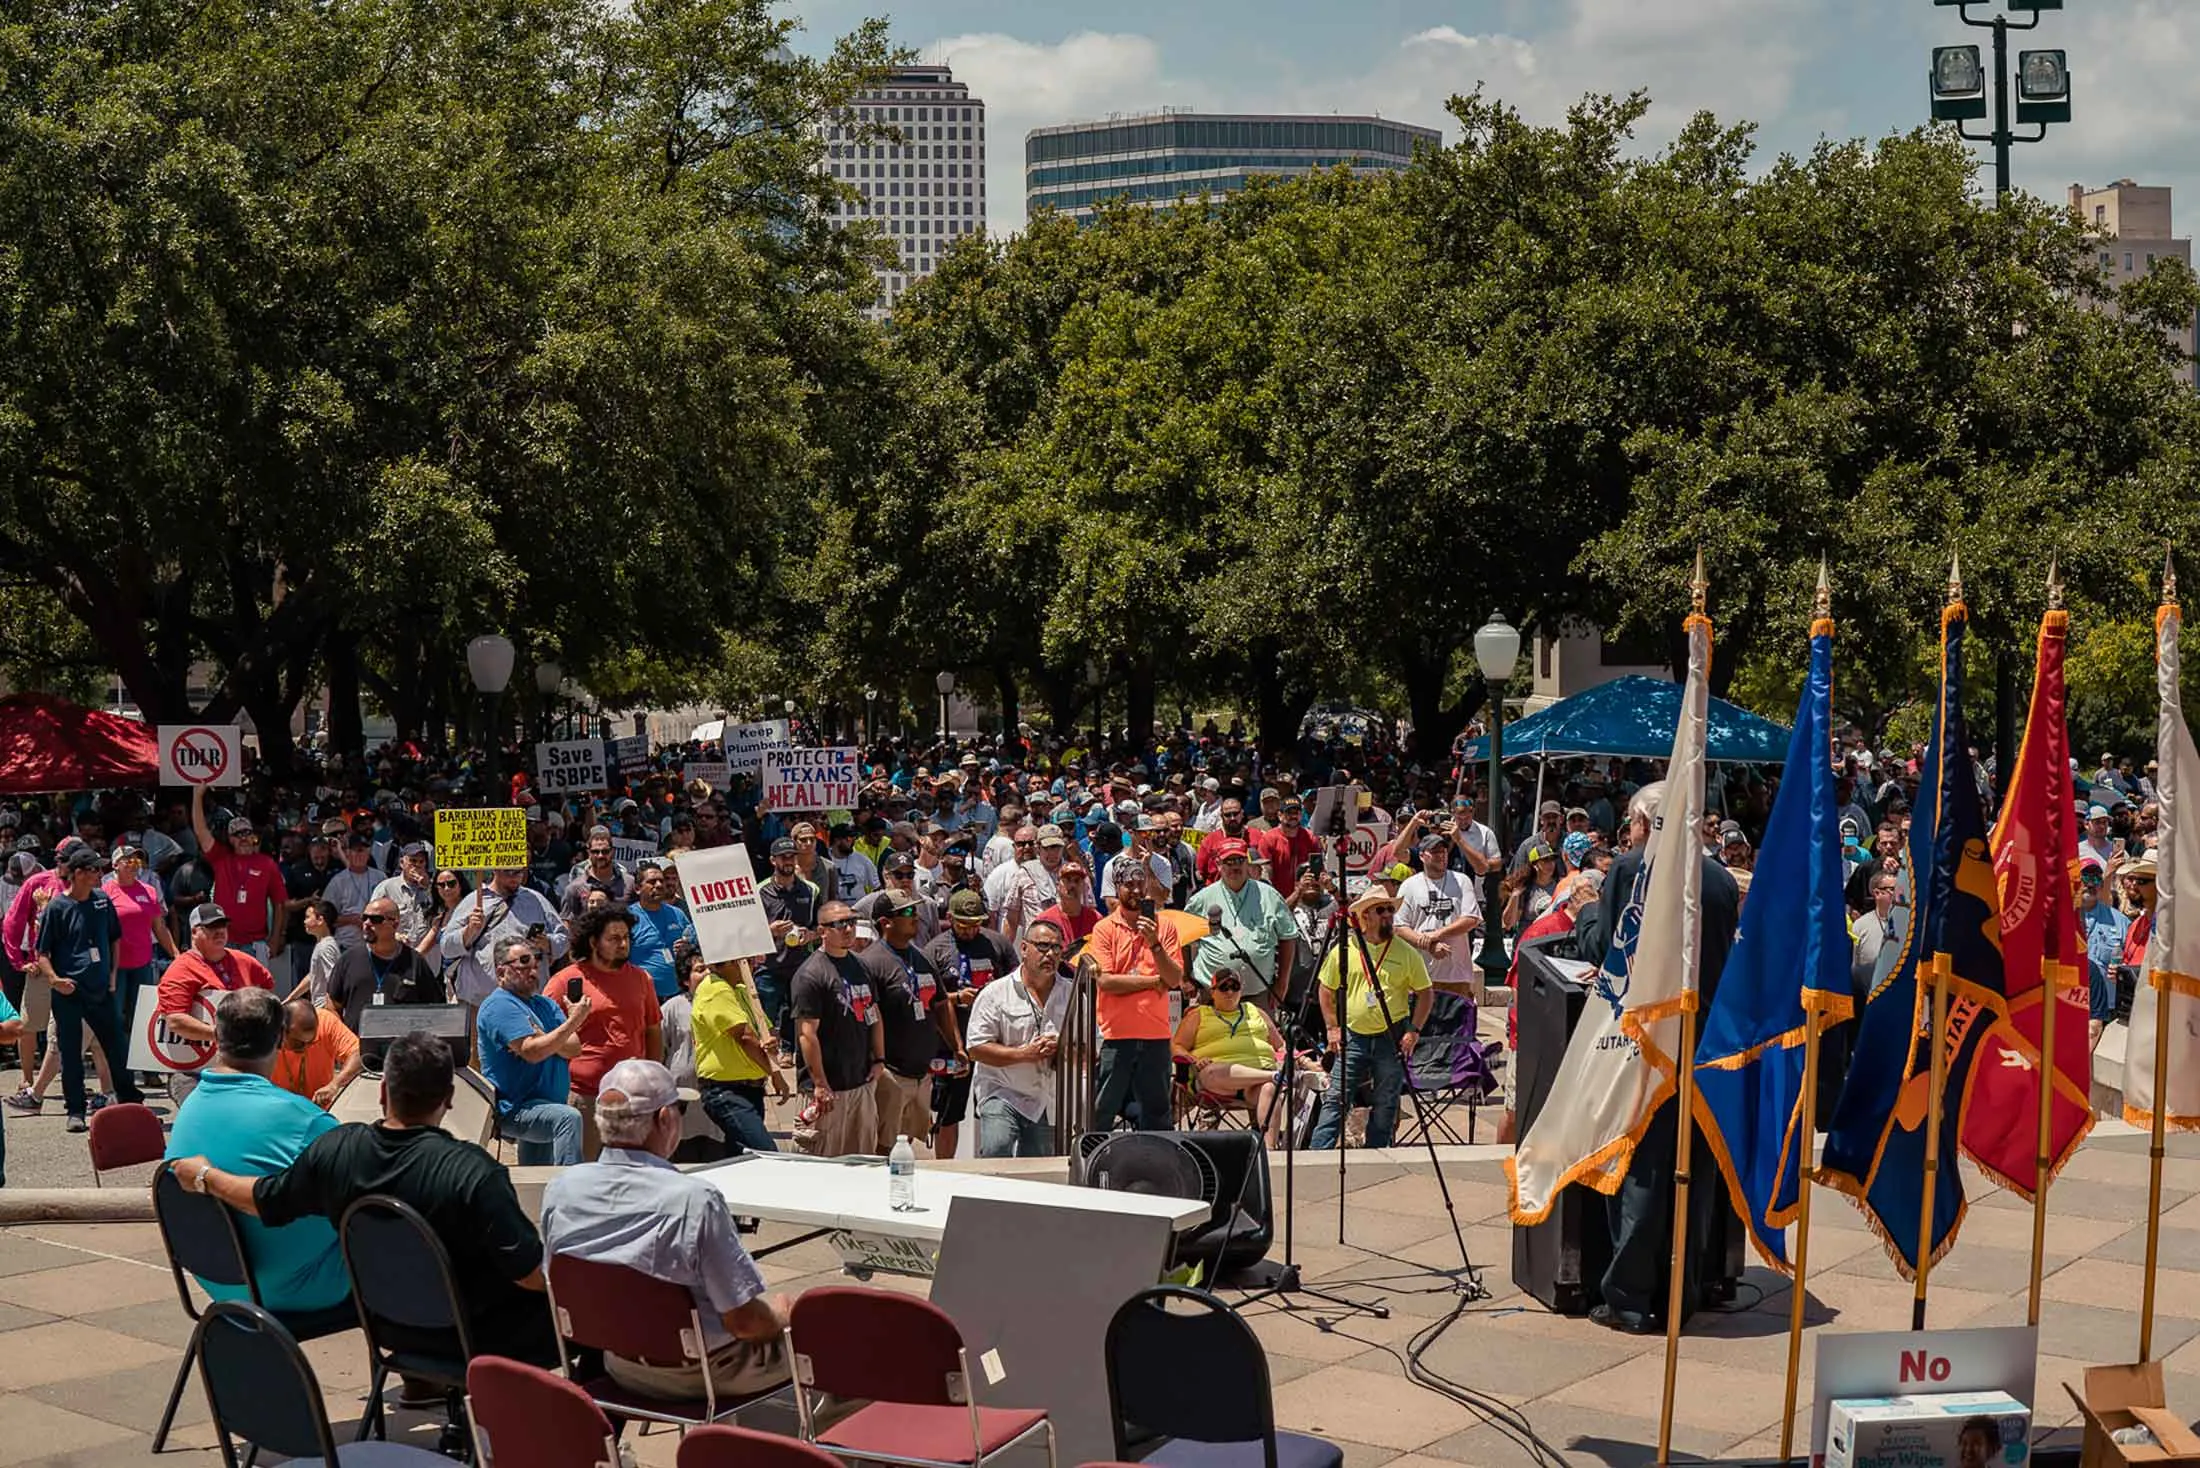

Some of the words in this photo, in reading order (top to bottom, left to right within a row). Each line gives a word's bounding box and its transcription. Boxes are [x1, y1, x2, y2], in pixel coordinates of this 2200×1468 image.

[739, 727, 774, 740] Keep
[727, 740, 790, 755] Plumbers
[177, 748, 220, 766] TDLR
[549, 747, 592, 766] Save
[767, 750, 834, 767] PROTECT
[542, 765, 604, 788] TSBPE
[780, 766, 853, 783] TEXANS
[768, 783, 858, 808] HEALTH!
[439, 810, 497, 823] BARBARIANS
[451, 823, 468, 831] THE
[472, 820, 496, 829] ROMAN
[451, 831, 466, 842] AND
[499, 829, 526, 841] YEARS
[437, 844, 448, 856] OF
[453, 842, 492, 855] PLUMBING
[467, 855, 481, 866] NOT
[690, 885, 701, 905] I
[700, 876, 754, 903] VOTE!
[829, 1231, 880, 1253] THIS
[883, 1237, 926, 1259] WILL
[1900, 1350, 1952, 1383] No
[1857, 1452, 1896, 1468] Baby
[1899, 1450, 1945, 1467] Wipes
